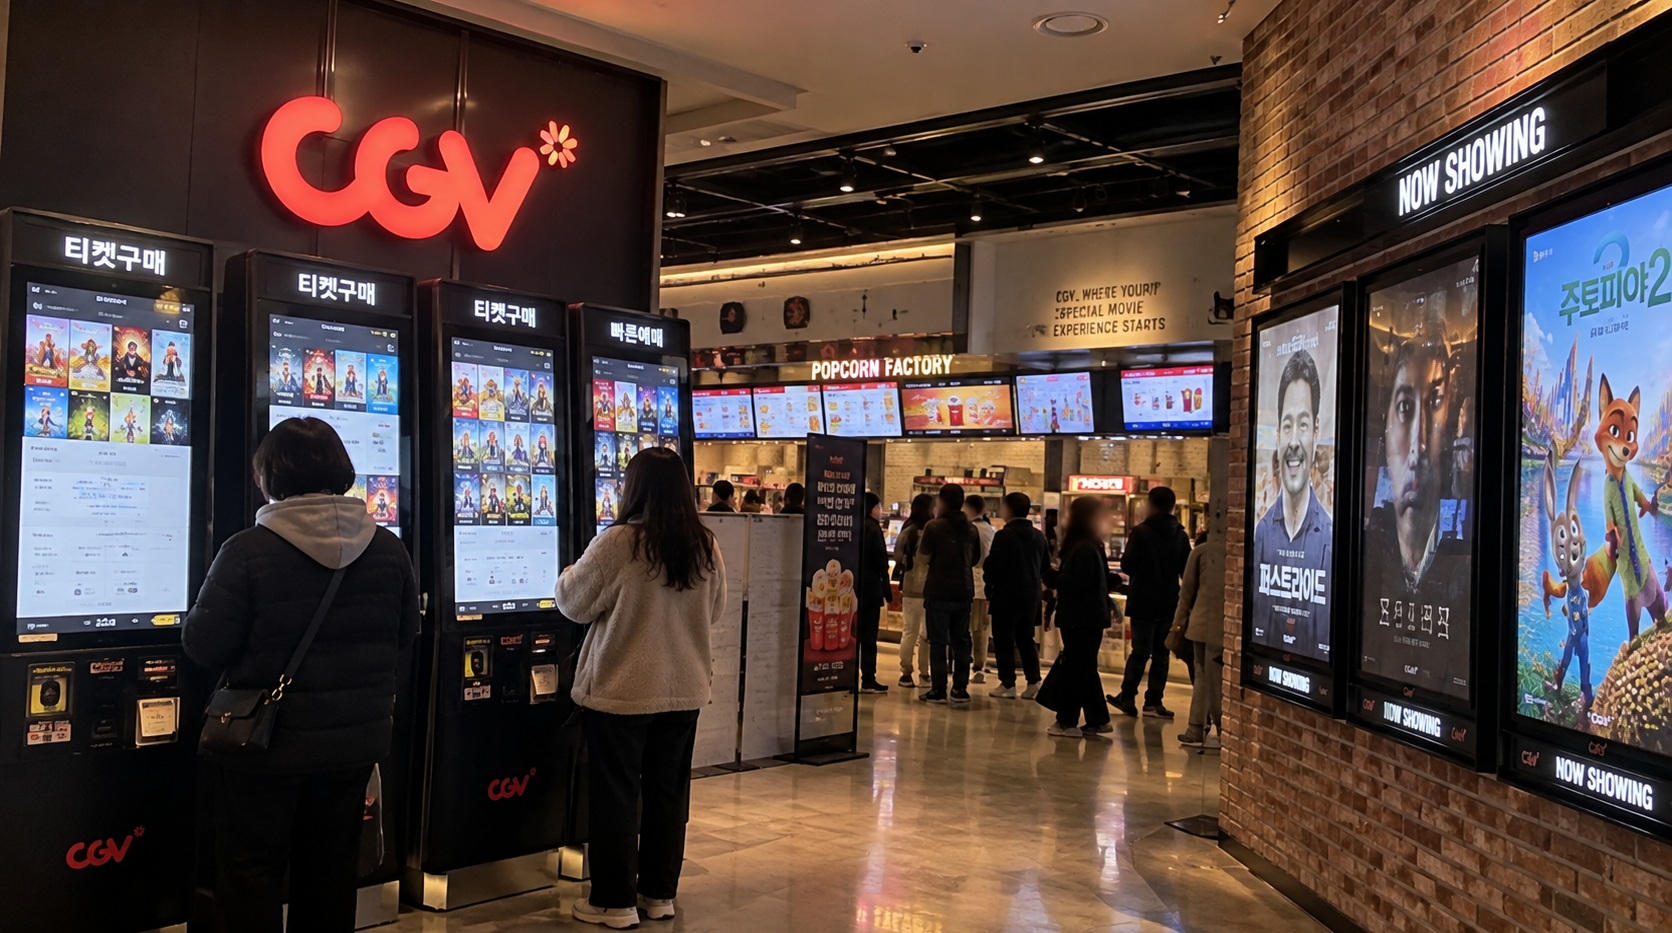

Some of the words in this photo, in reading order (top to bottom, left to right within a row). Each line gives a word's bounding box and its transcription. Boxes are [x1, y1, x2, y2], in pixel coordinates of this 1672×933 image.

[261, 95, 540, 251] CGV
[1399, 160, 1440, 216] NOW
[1444, 106, 1546, 194] SHOWING
[65, 236, 166, 276] 티켓구매
[298, 273, 376, 306] 티켓구매
[474, 299, 536, 328] 티켓구매
[1108, 300, 1144, 316] MOVIE
[1053, 320, 1119, 337] EXPERIENCE
[1122, 317, 1166, 333] STARTS
[811, 359, 880, 381] POPCORN
[884, 354, 955, 377] FACTORY
[1383, 701, 1403, 725] NOW
[1402, 708, 1441, 738] SHOWING
[487, 774, 530, 801] CGV
[1555, 755, 1585, 787] NOW
[1586, 765, 1654, 811] SHOWING
[65, 834, 134, 870] CGV
